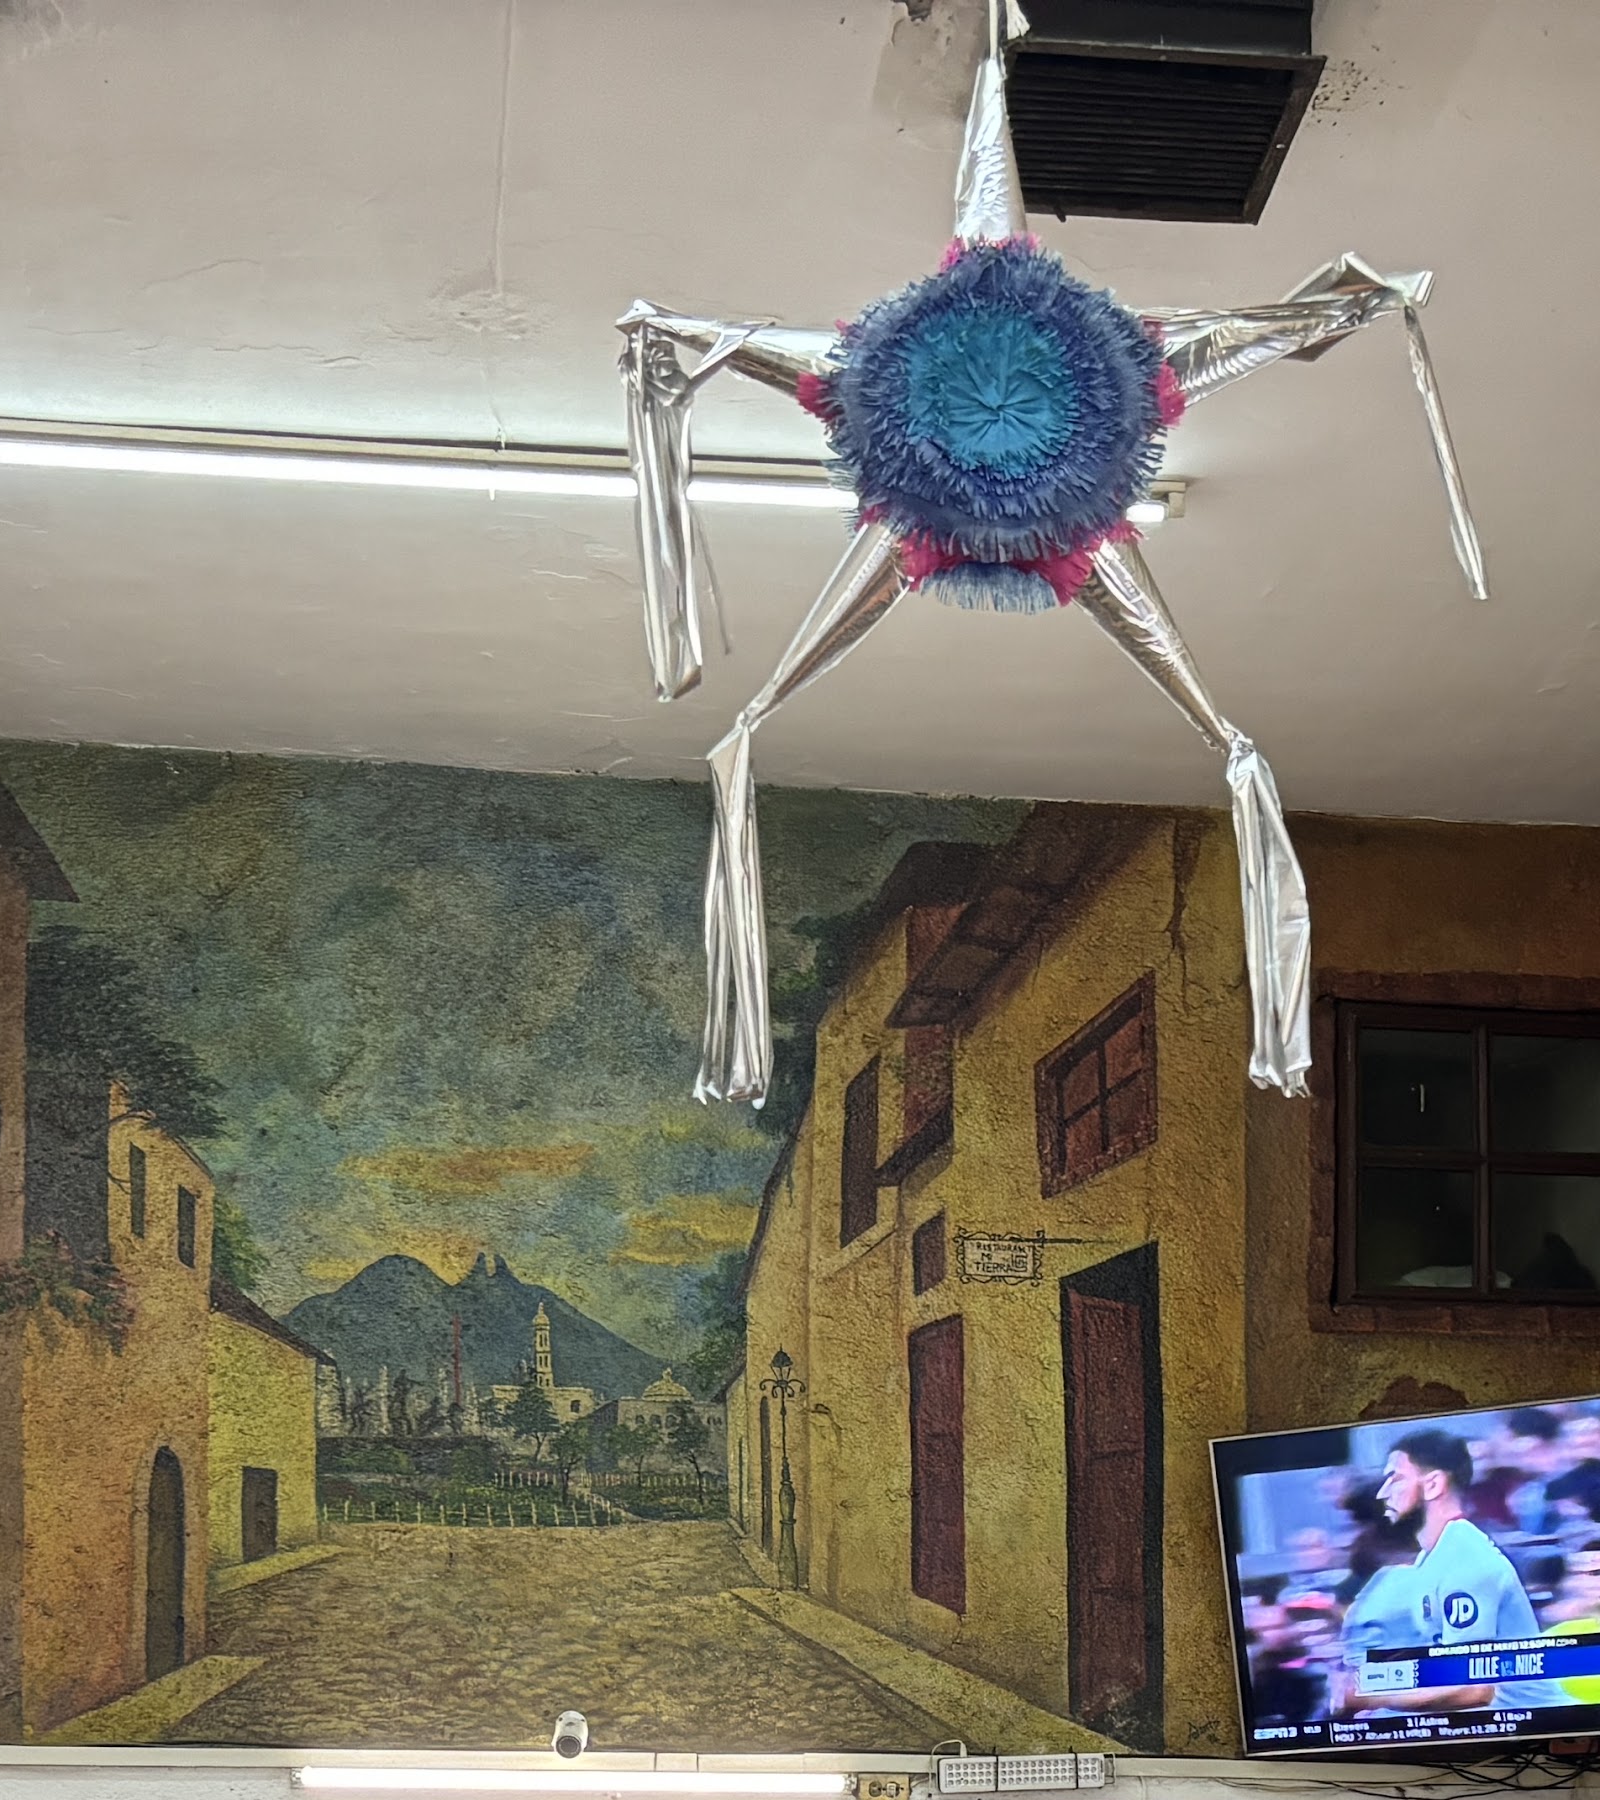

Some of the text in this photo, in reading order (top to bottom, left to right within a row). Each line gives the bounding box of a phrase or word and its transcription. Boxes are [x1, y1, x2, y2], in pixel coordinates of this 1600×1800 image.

[974, 1262, 1012, 1273] TIERRA
[1450, 1598, 1475, 1624] JD
[1469, 1656, 1500, 1679] LILLE
[1515, 1653, 1545, 1676] NICE
